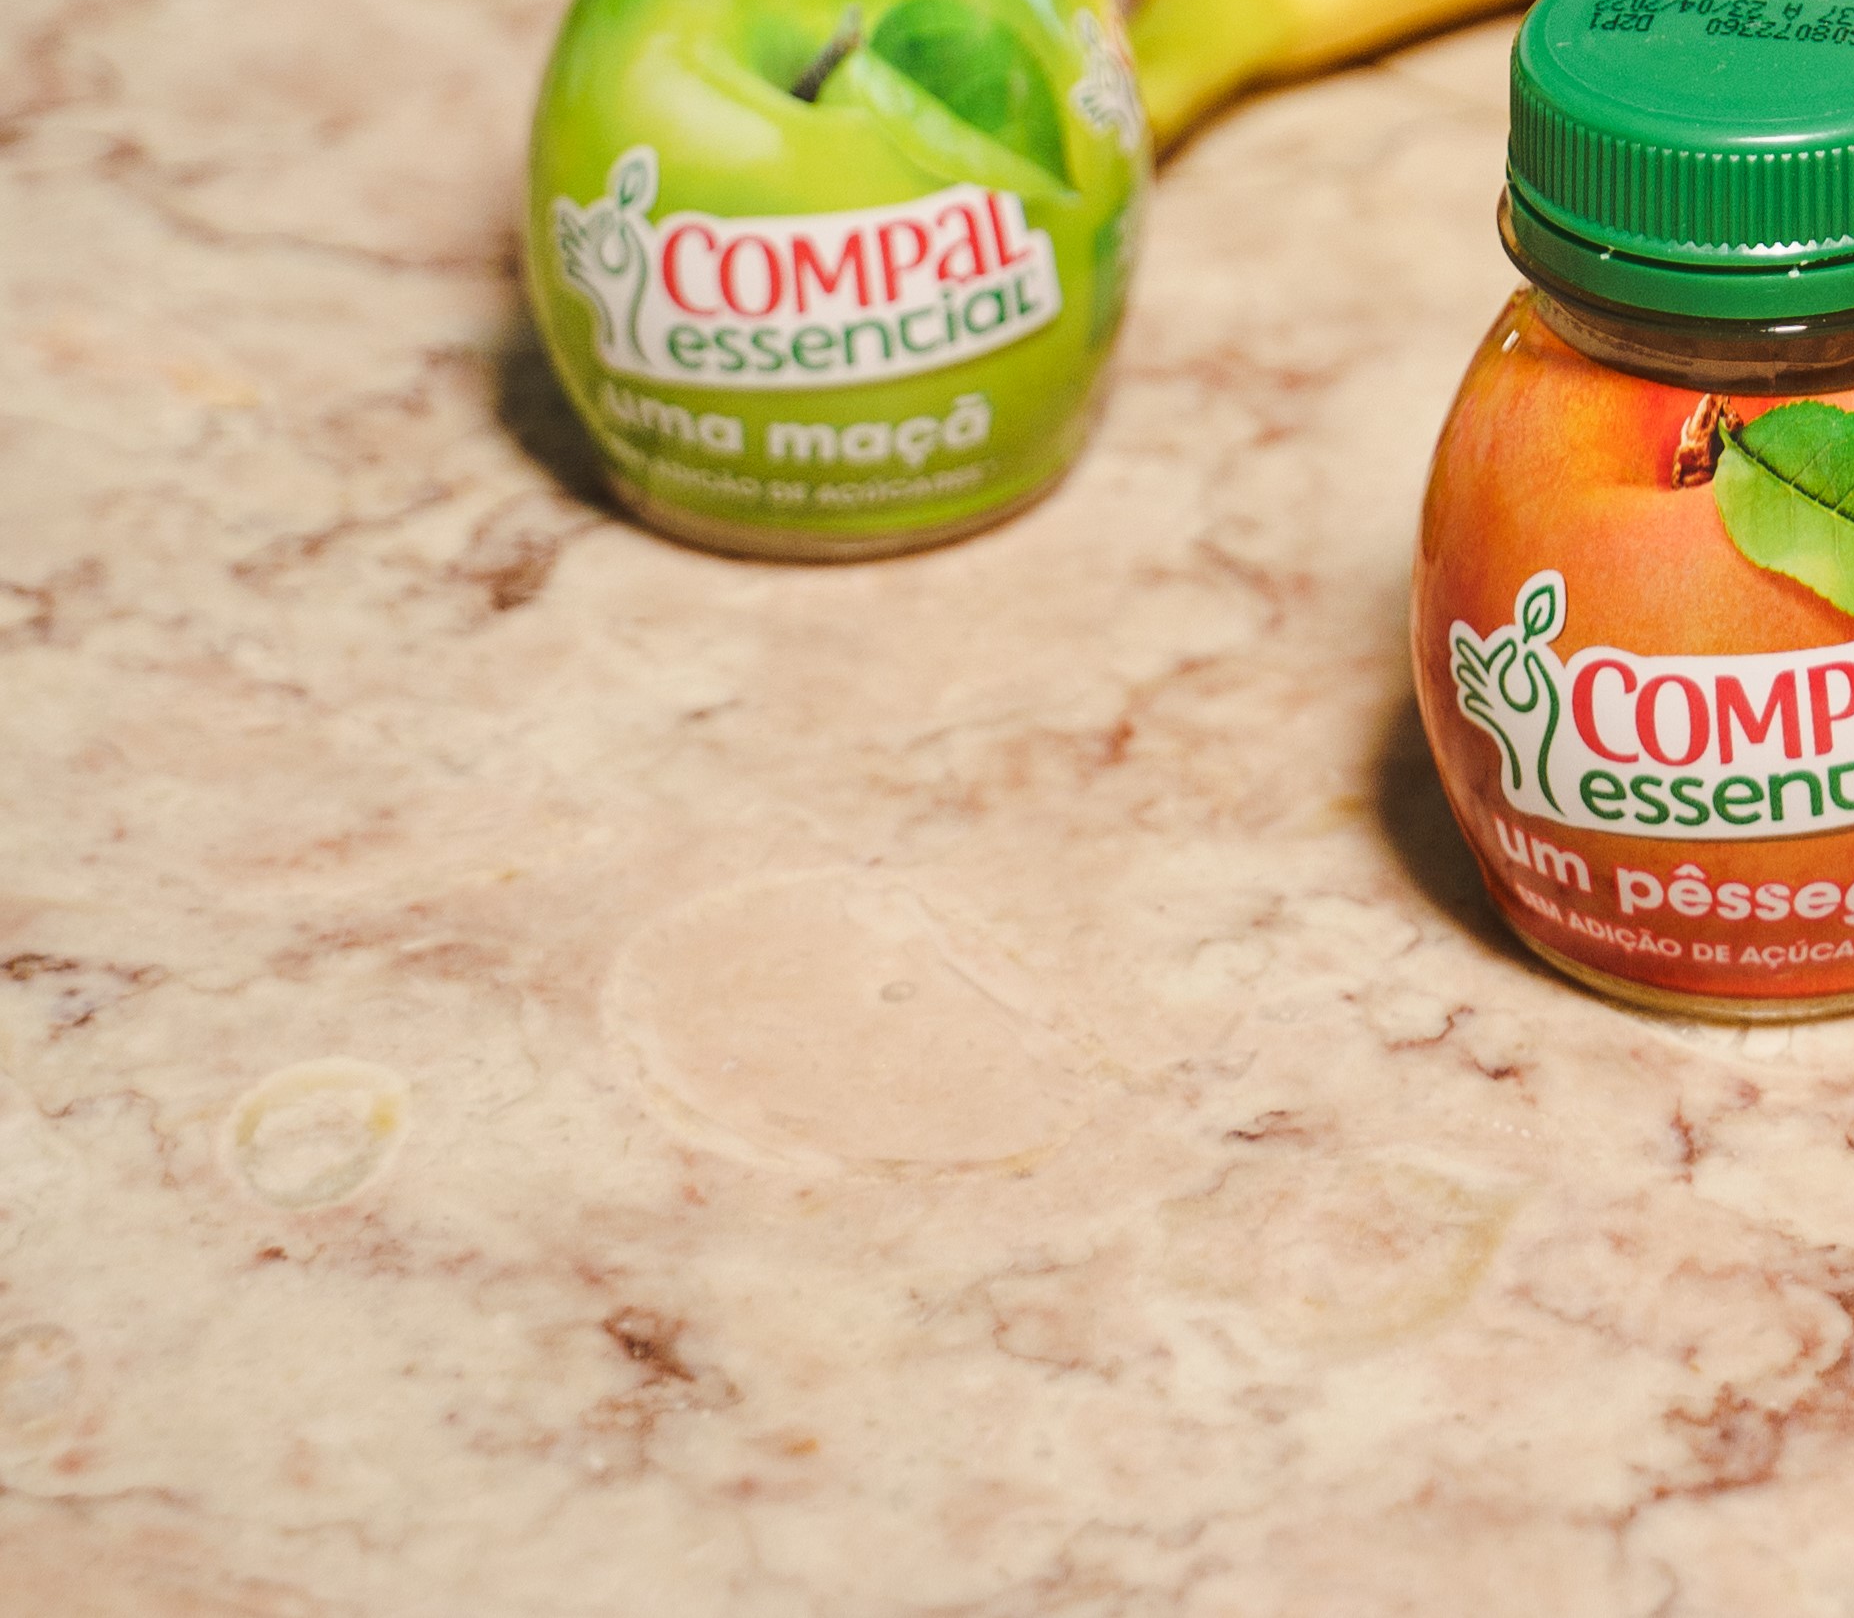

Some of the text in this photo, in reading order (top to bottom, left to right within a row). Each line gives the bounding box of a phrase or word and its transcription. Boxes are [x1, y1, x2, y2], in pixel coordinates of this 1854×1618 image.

[1782, 2, 1804, 21] A
[604, 382, 745, 454] uma
[766, 391, 993, 470] maçã
[1495, 816, 1593, 893] um
[1568, 914, 1683, 958] ADIÇÃO
[1691, 941, 1731, 963] DE
